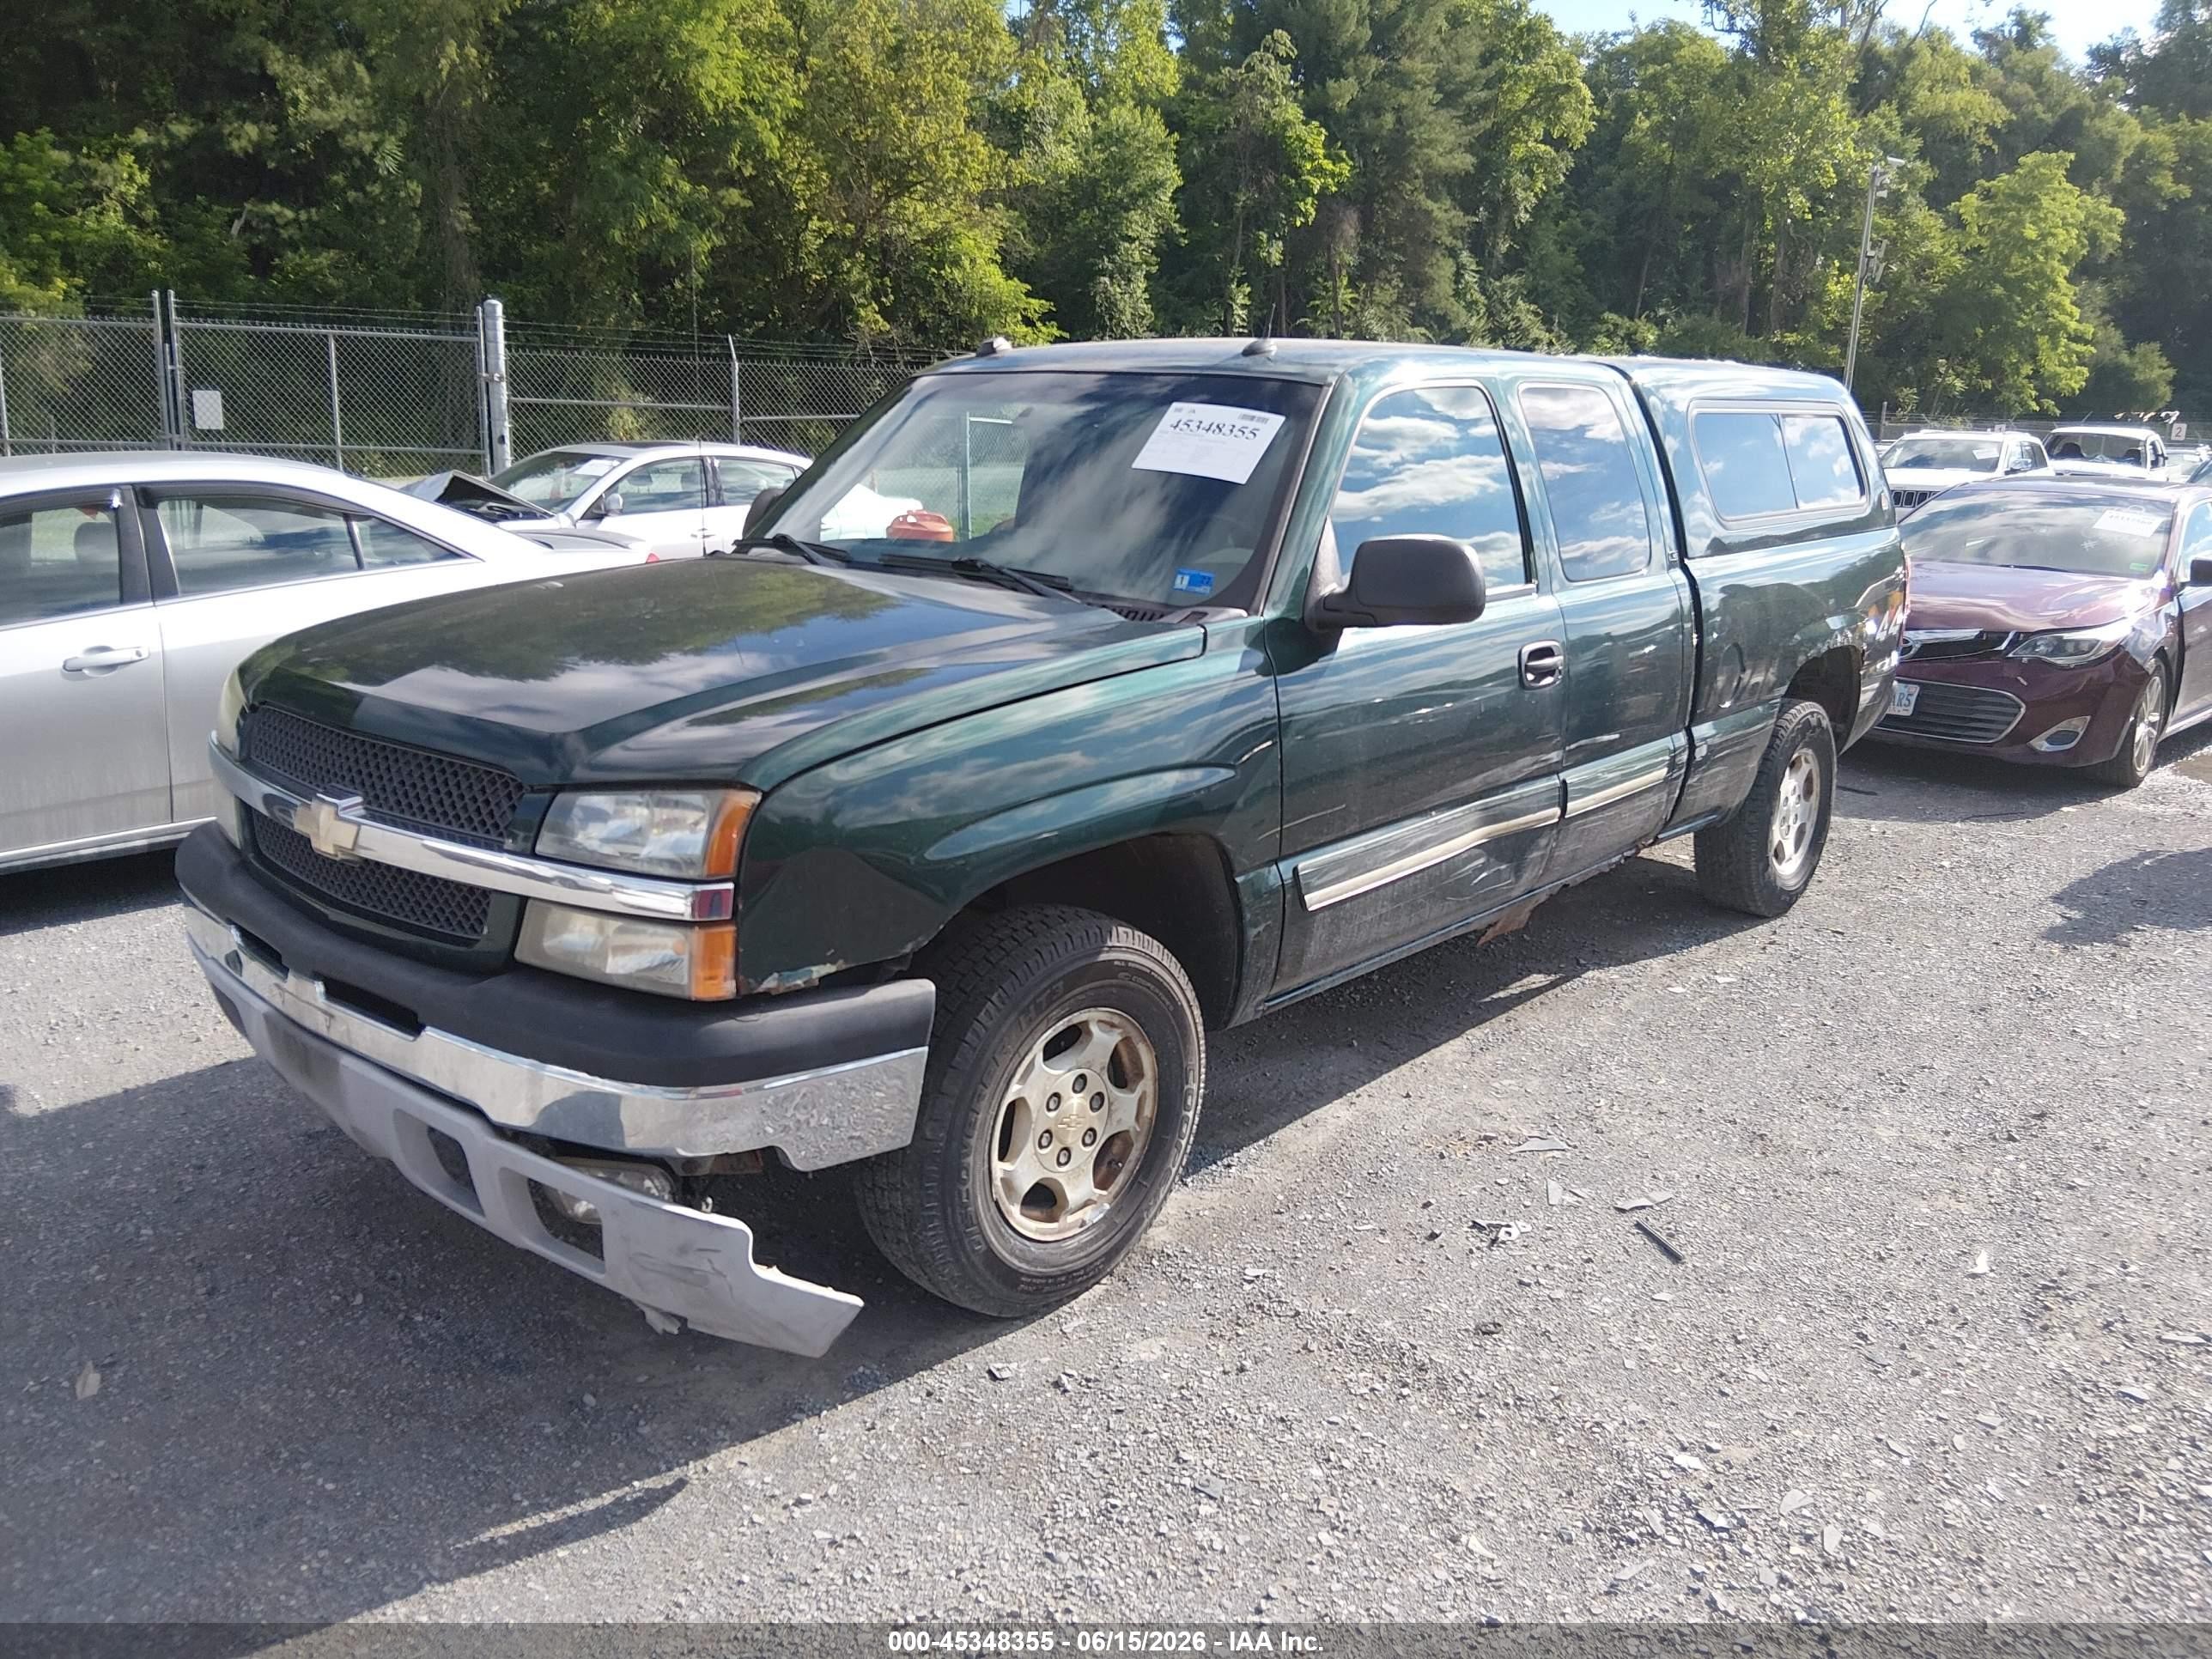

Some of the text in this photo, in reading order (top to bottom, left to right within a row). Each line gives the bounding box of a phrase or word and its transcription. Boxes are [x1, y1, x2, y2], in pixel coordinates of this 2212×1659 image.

[1170, 419, 1261, 440] 45348355
[2174, 427, 2182, 437] 2
[1143, 1063, 1195, 1220] COOPER
